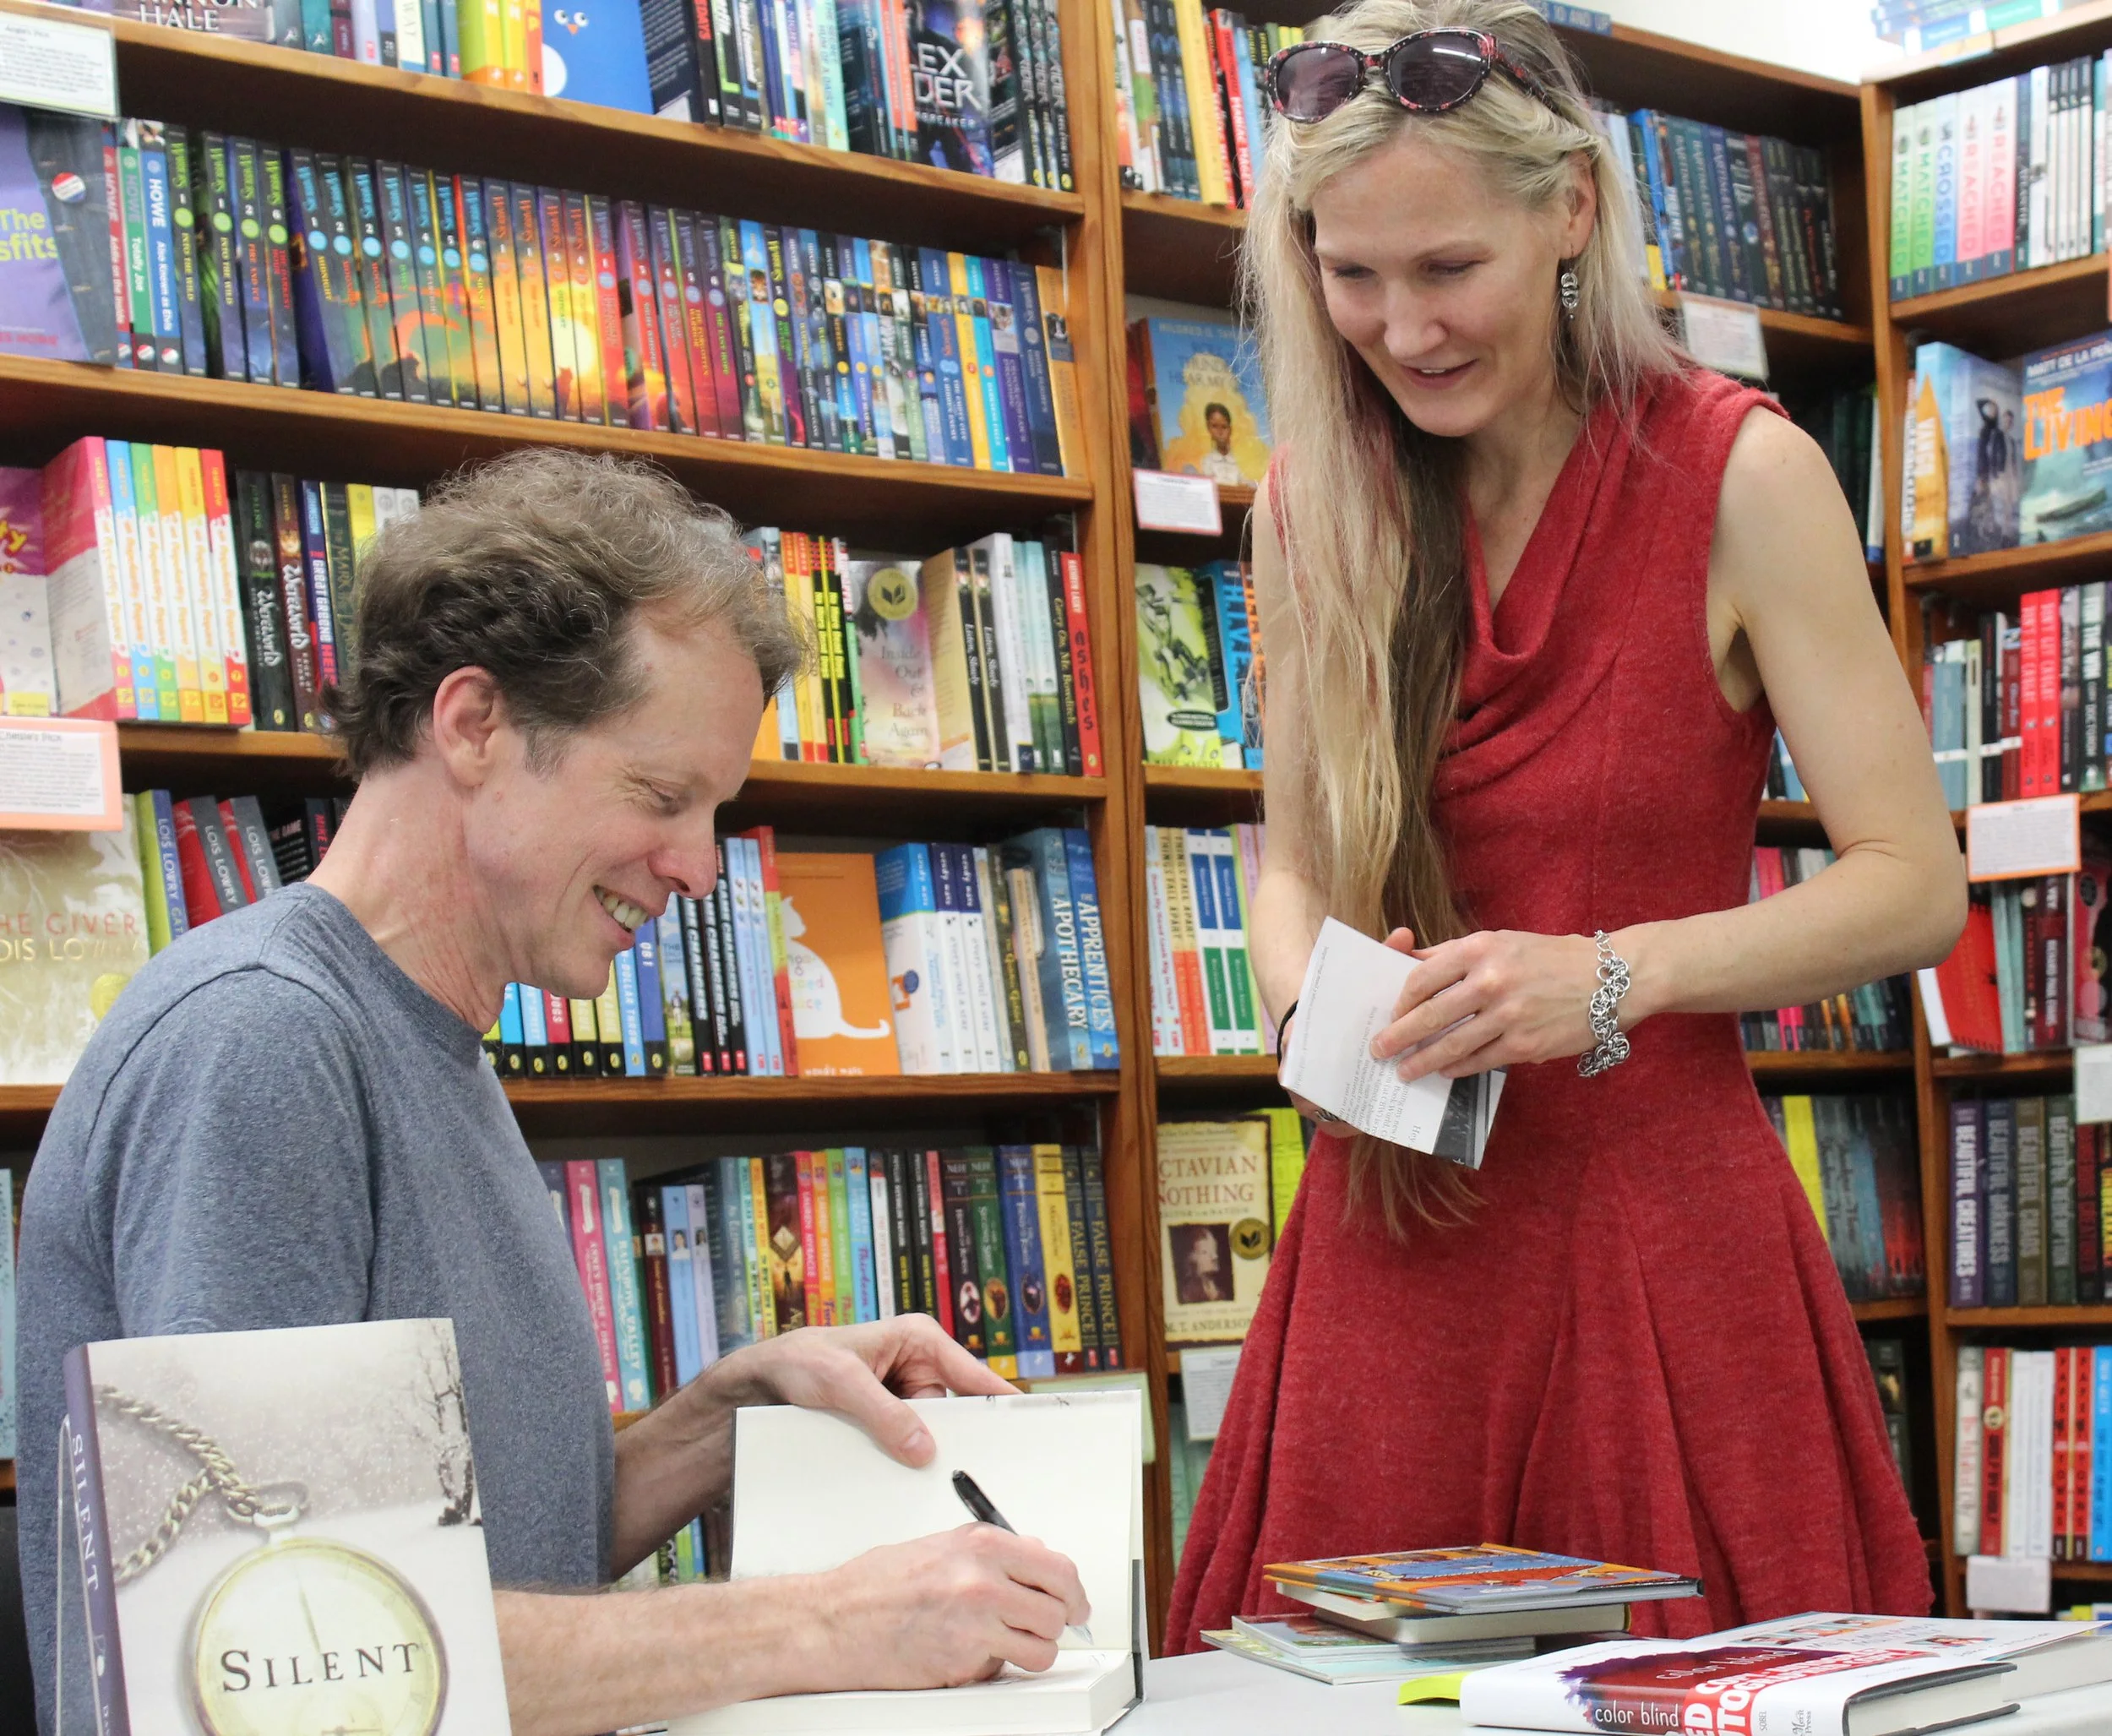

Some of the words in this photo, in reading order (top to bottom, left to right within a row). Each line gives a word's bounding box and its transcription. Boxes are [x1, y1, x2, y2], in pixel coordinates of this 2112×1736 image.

[141, 5, 218, 32] HALE
[149, 178, 166, 228] HOWE
[157, 819, 175, 847] LOIS
[246, 826, 262, 855] LOIS
[315, 814, 328, 842] MIKE
[162, 853, 179, 899] LOWRY
[204, 825, 220, 855] LOIS
[215, 858, 238, 905] LOWRY
[46, 912, 140, 937] GIVER
[1052, 898, 1088, 1030] APOTHECARY
[1076, 901, 1113, 1031] APPRENTICES
[1071, 1221, 1088, 1268] FALSE
[1091, 1221, 1108, 1266] FALSE
[1077, 1275, 1096, 1332] PRINCE
[1098, 1274, 1115, 1332] PRINCE
[626, 1315, 640, 1370] VALLEY
[72, 1434, 99, 1592] SILENT
[220, 1641, 423, 1693] SILENT
[1594, 1699, 1634, 1725] color
[1641, 1702, 1679, 1728] blind
[1759, 1711, 1767, 1730] SOBEL
